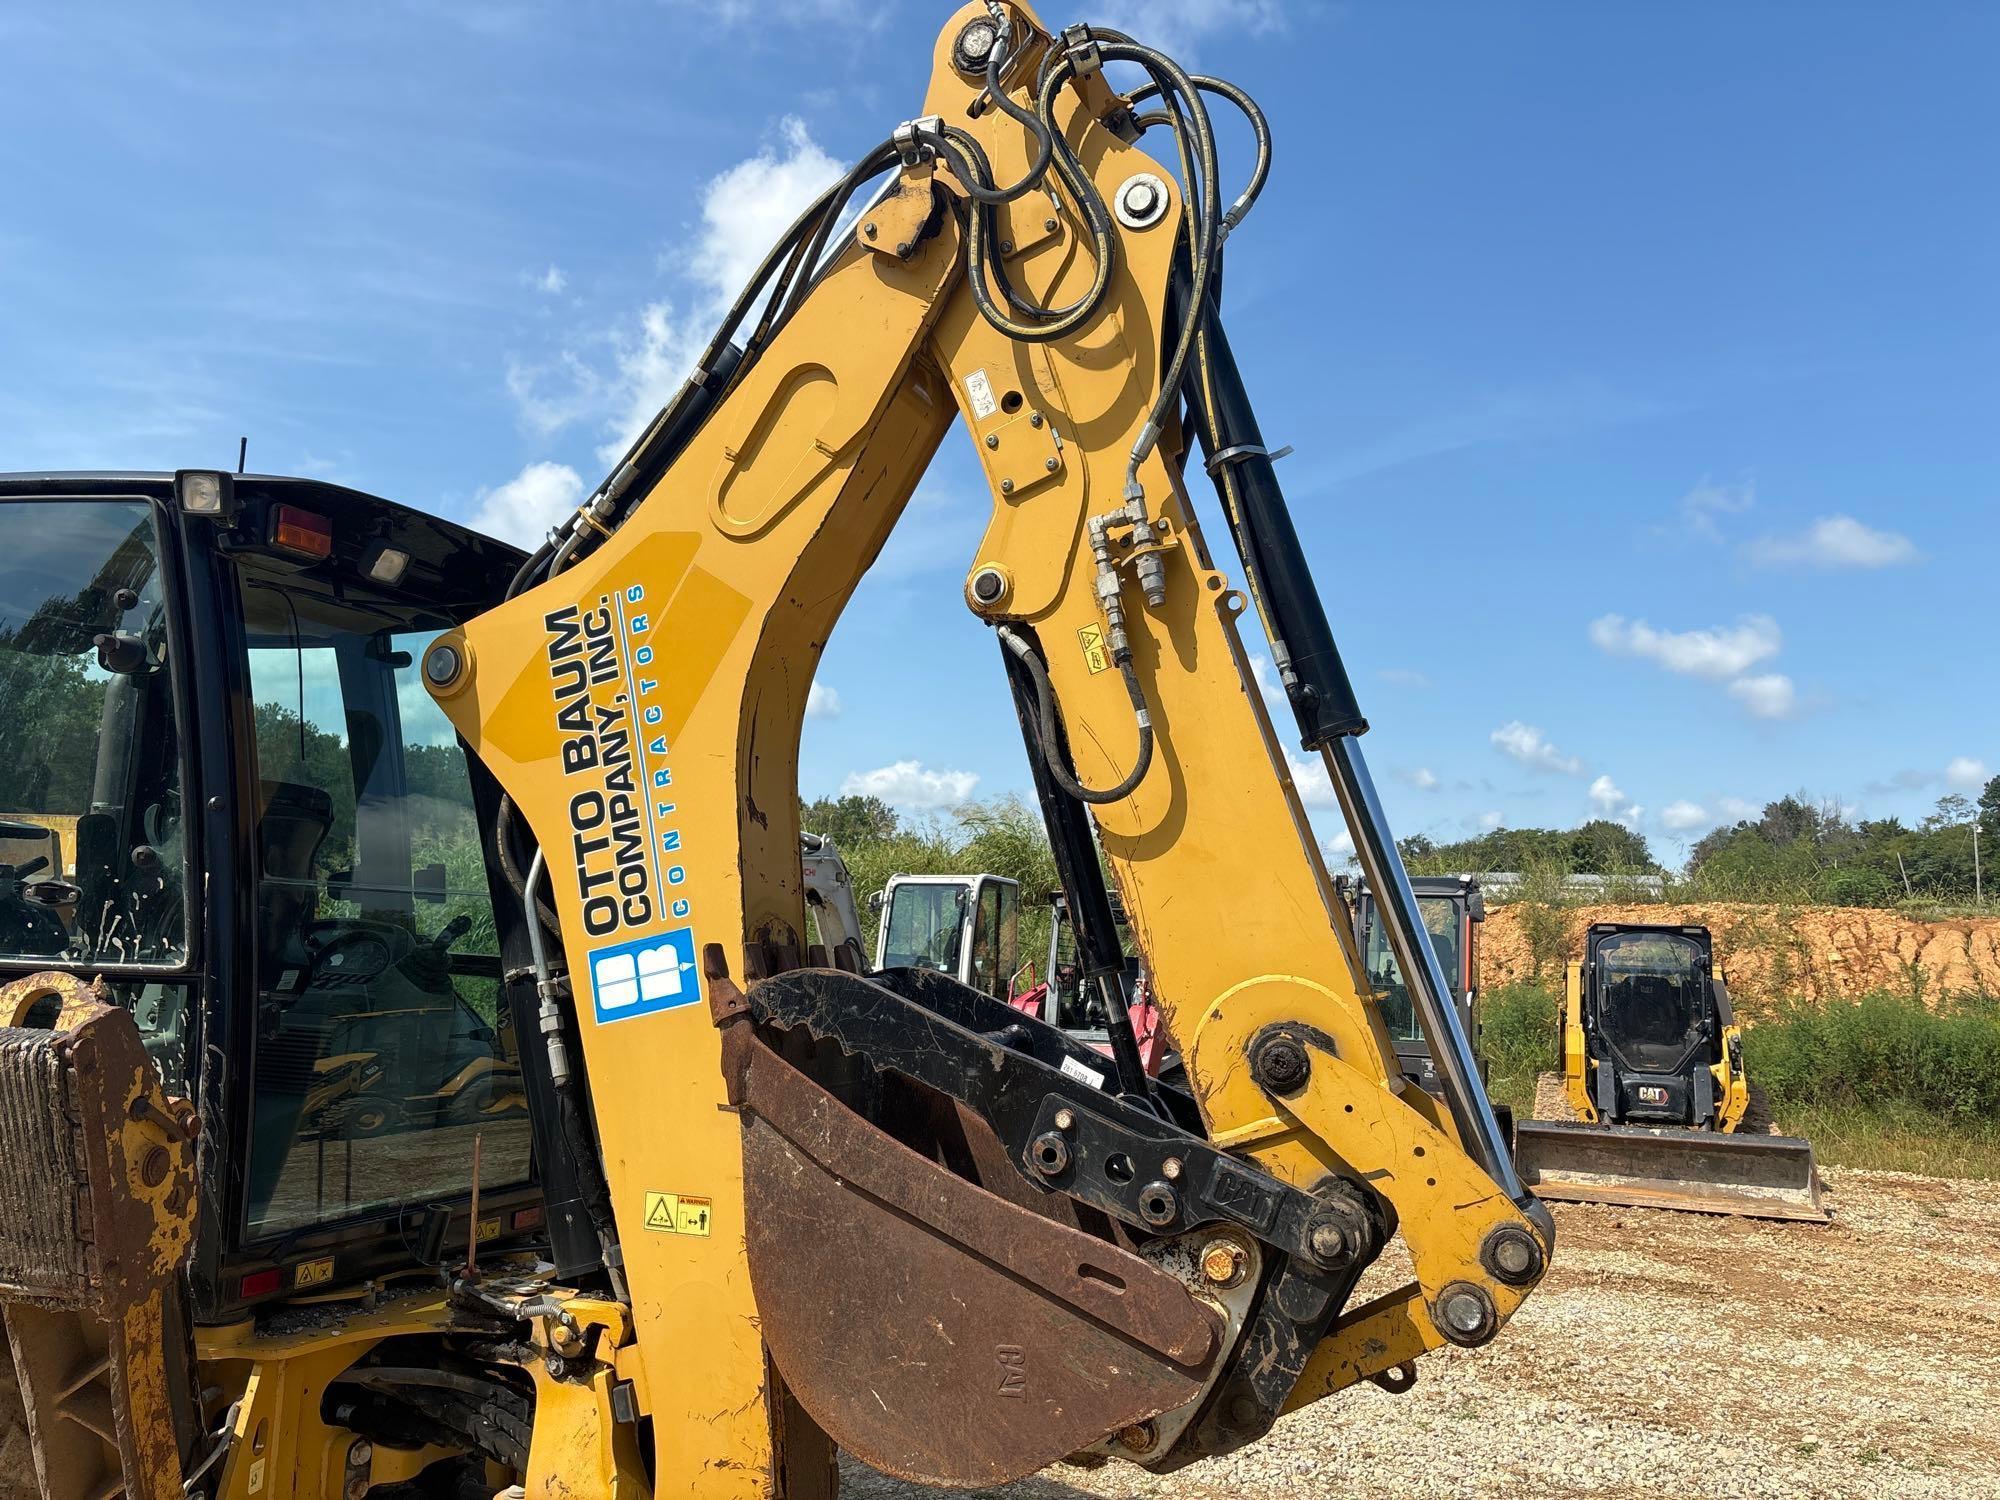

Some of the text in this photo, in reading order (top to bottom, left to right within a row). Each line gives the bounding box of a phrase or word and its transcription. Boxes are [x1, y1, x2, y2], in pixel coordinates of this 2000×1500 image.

[544, 603, 619, 936] OTTO BAUM
[582, 594, 652, 927] COMPANY, INC.
[627, 584, 690, 918] CONTRACTORS
[1639, 1086, 1661, 1101] CAT
[1213, 1171, 1275, 1222] CAT
[995, 1344, 1027, 1402] CAT
